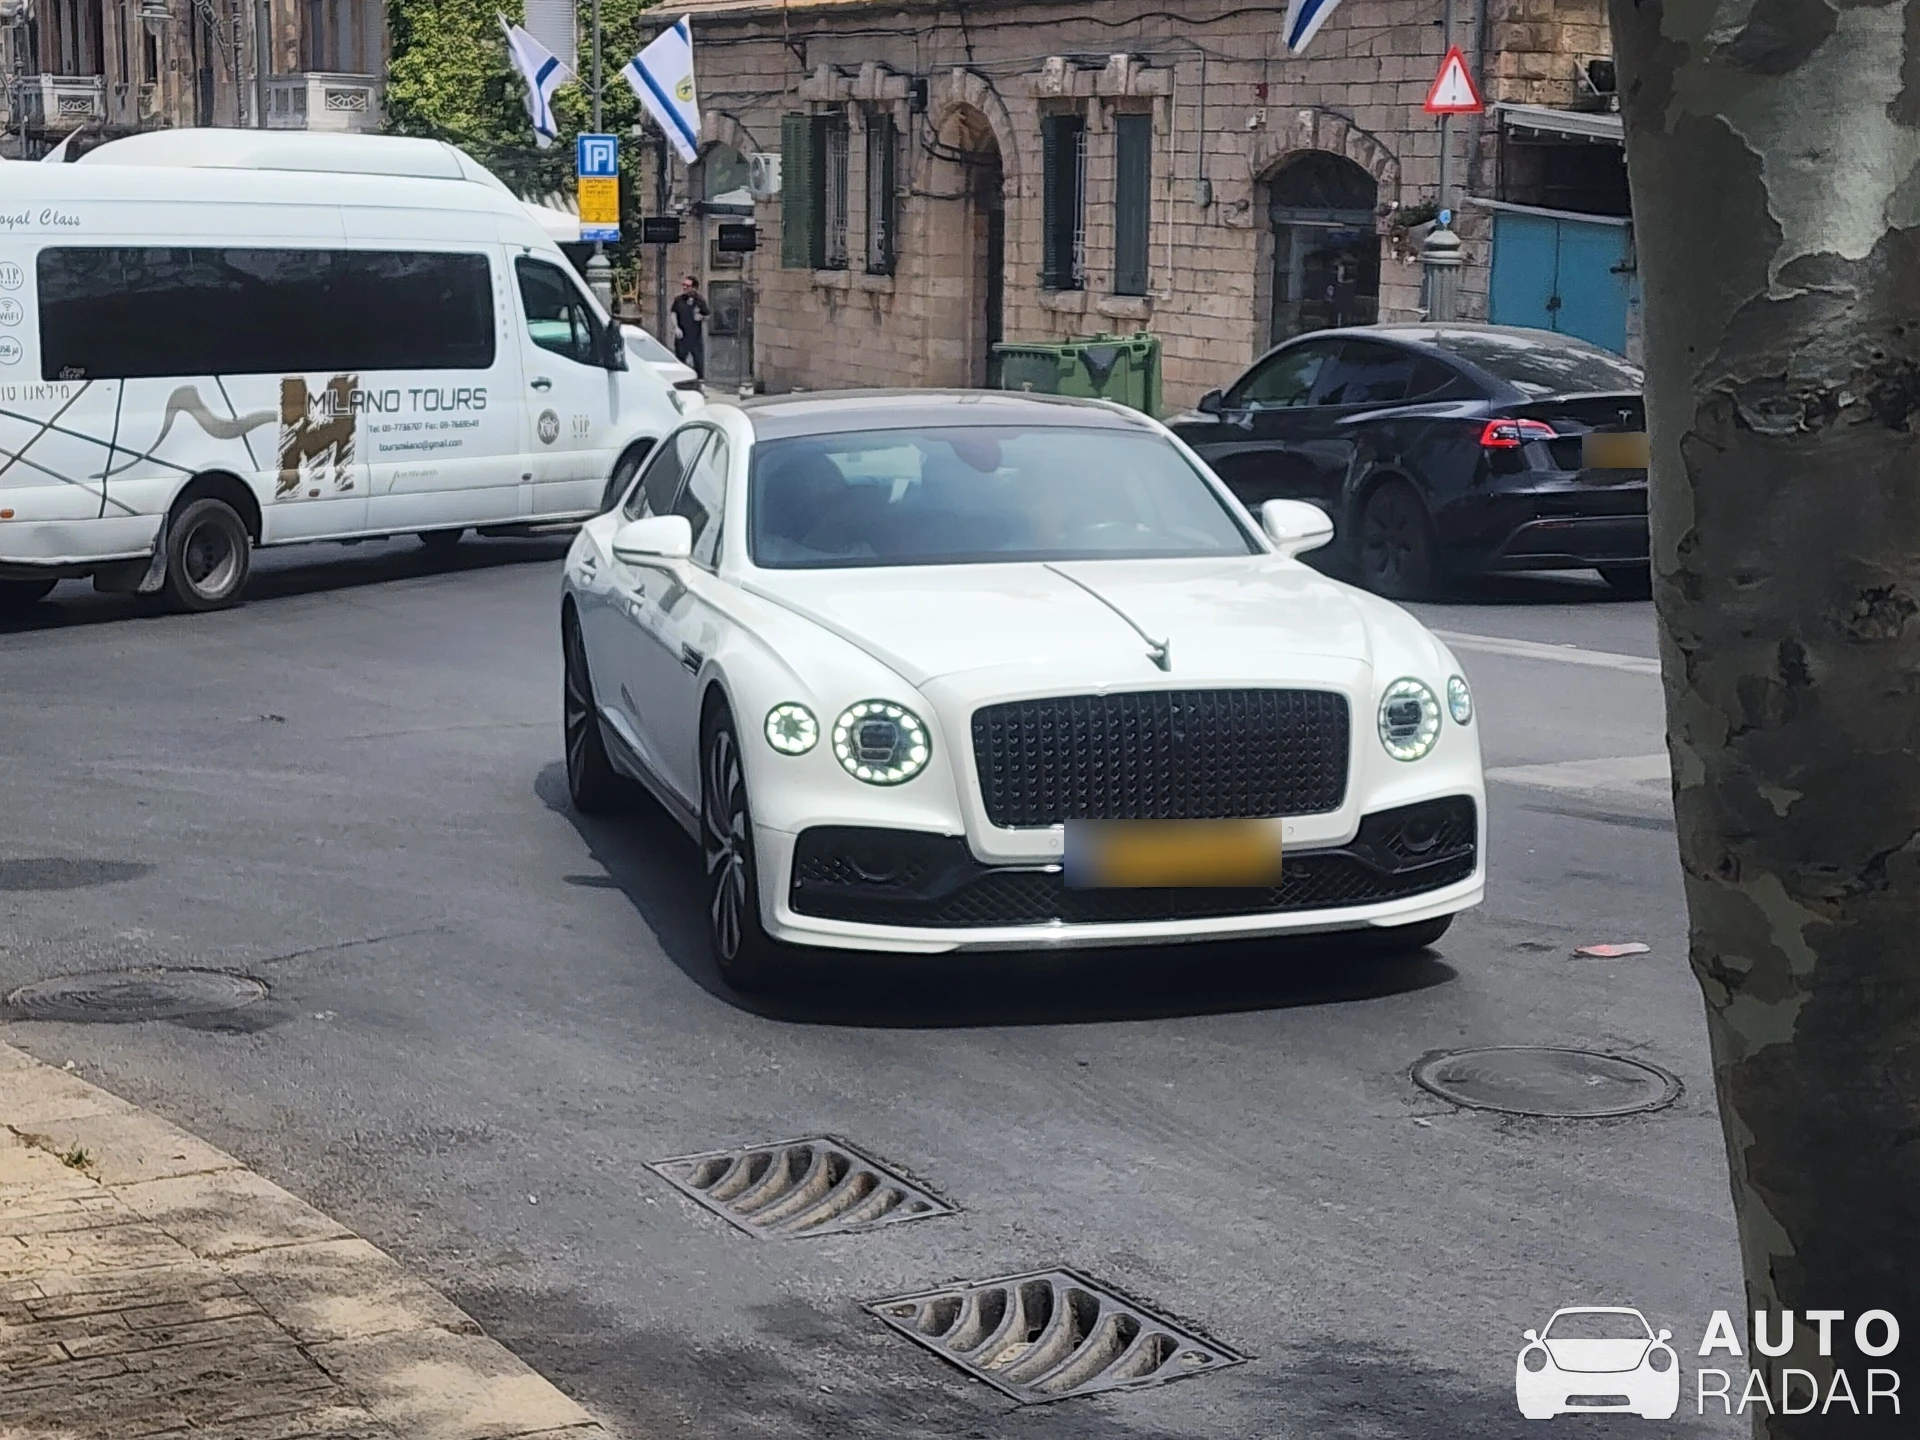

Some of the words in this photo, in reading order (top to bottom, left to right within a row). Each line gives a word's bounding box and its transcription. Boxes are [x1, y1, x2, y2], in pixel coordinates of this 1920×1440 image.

[0, 209, 31, 230] oyal
[40, 208, 81, 226] Class
[1, 386, 16, 402] טו
[23, 383, 70, 401] מילאנו
[307, 389, 400, 416] MILANO
[408, 388, 488, 412] TOURS
